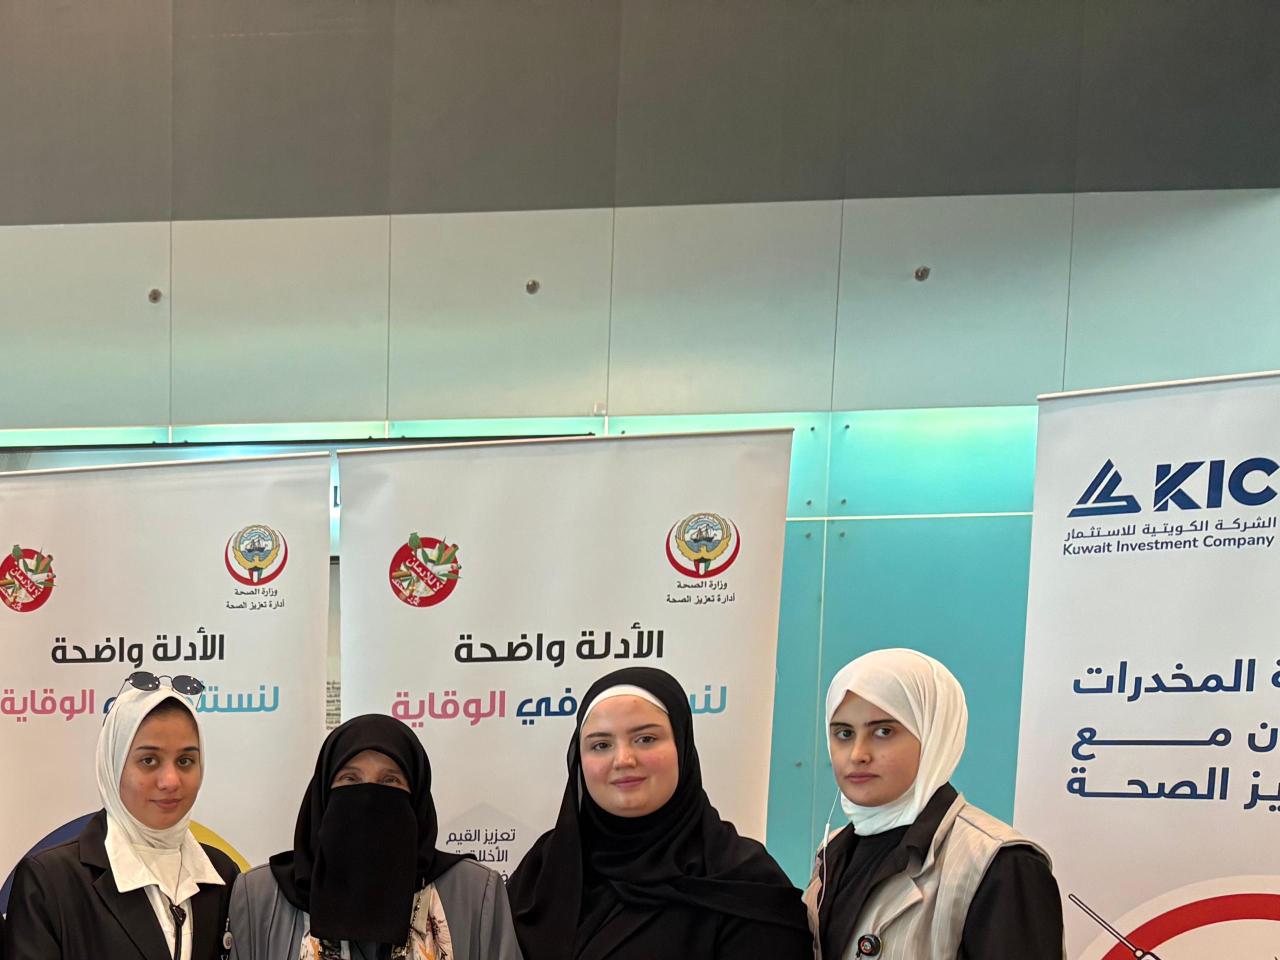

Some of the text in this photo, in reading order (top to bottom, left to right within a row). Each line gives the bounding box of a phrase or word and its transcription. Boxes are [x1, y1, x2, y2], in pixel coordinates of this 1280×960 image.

[1153, 456, 1280, 512] KIC
[1063, 516, 1277, 542] الشركة الكويتية للاستثمار
[1062, 532, 1275, 557] Kuwait Investment Company
[261, 587, 277, 597] وزارة
[676, 580, 728, 590] وزارة الصحة
[226, 600, 247, 609] الصحة
[249, 601, 267, 610] تعزيز
[666, 594, 691, 604] الصحة
[694, 594, 715, 604] تعزيز
[51, 626, 225, 669] الأدلة واضحة
[453, 622, 664, 668] الأدلة واضحة
[1073, 658, 1256, 703] المخدرات
[0, 689, 94, 722] الوقاية
[391, 687, 578, 729] في الوقاية
[1066, 766, 1230, 801] الصحة
[446, 829, 516, 845] تعزيز القيم
